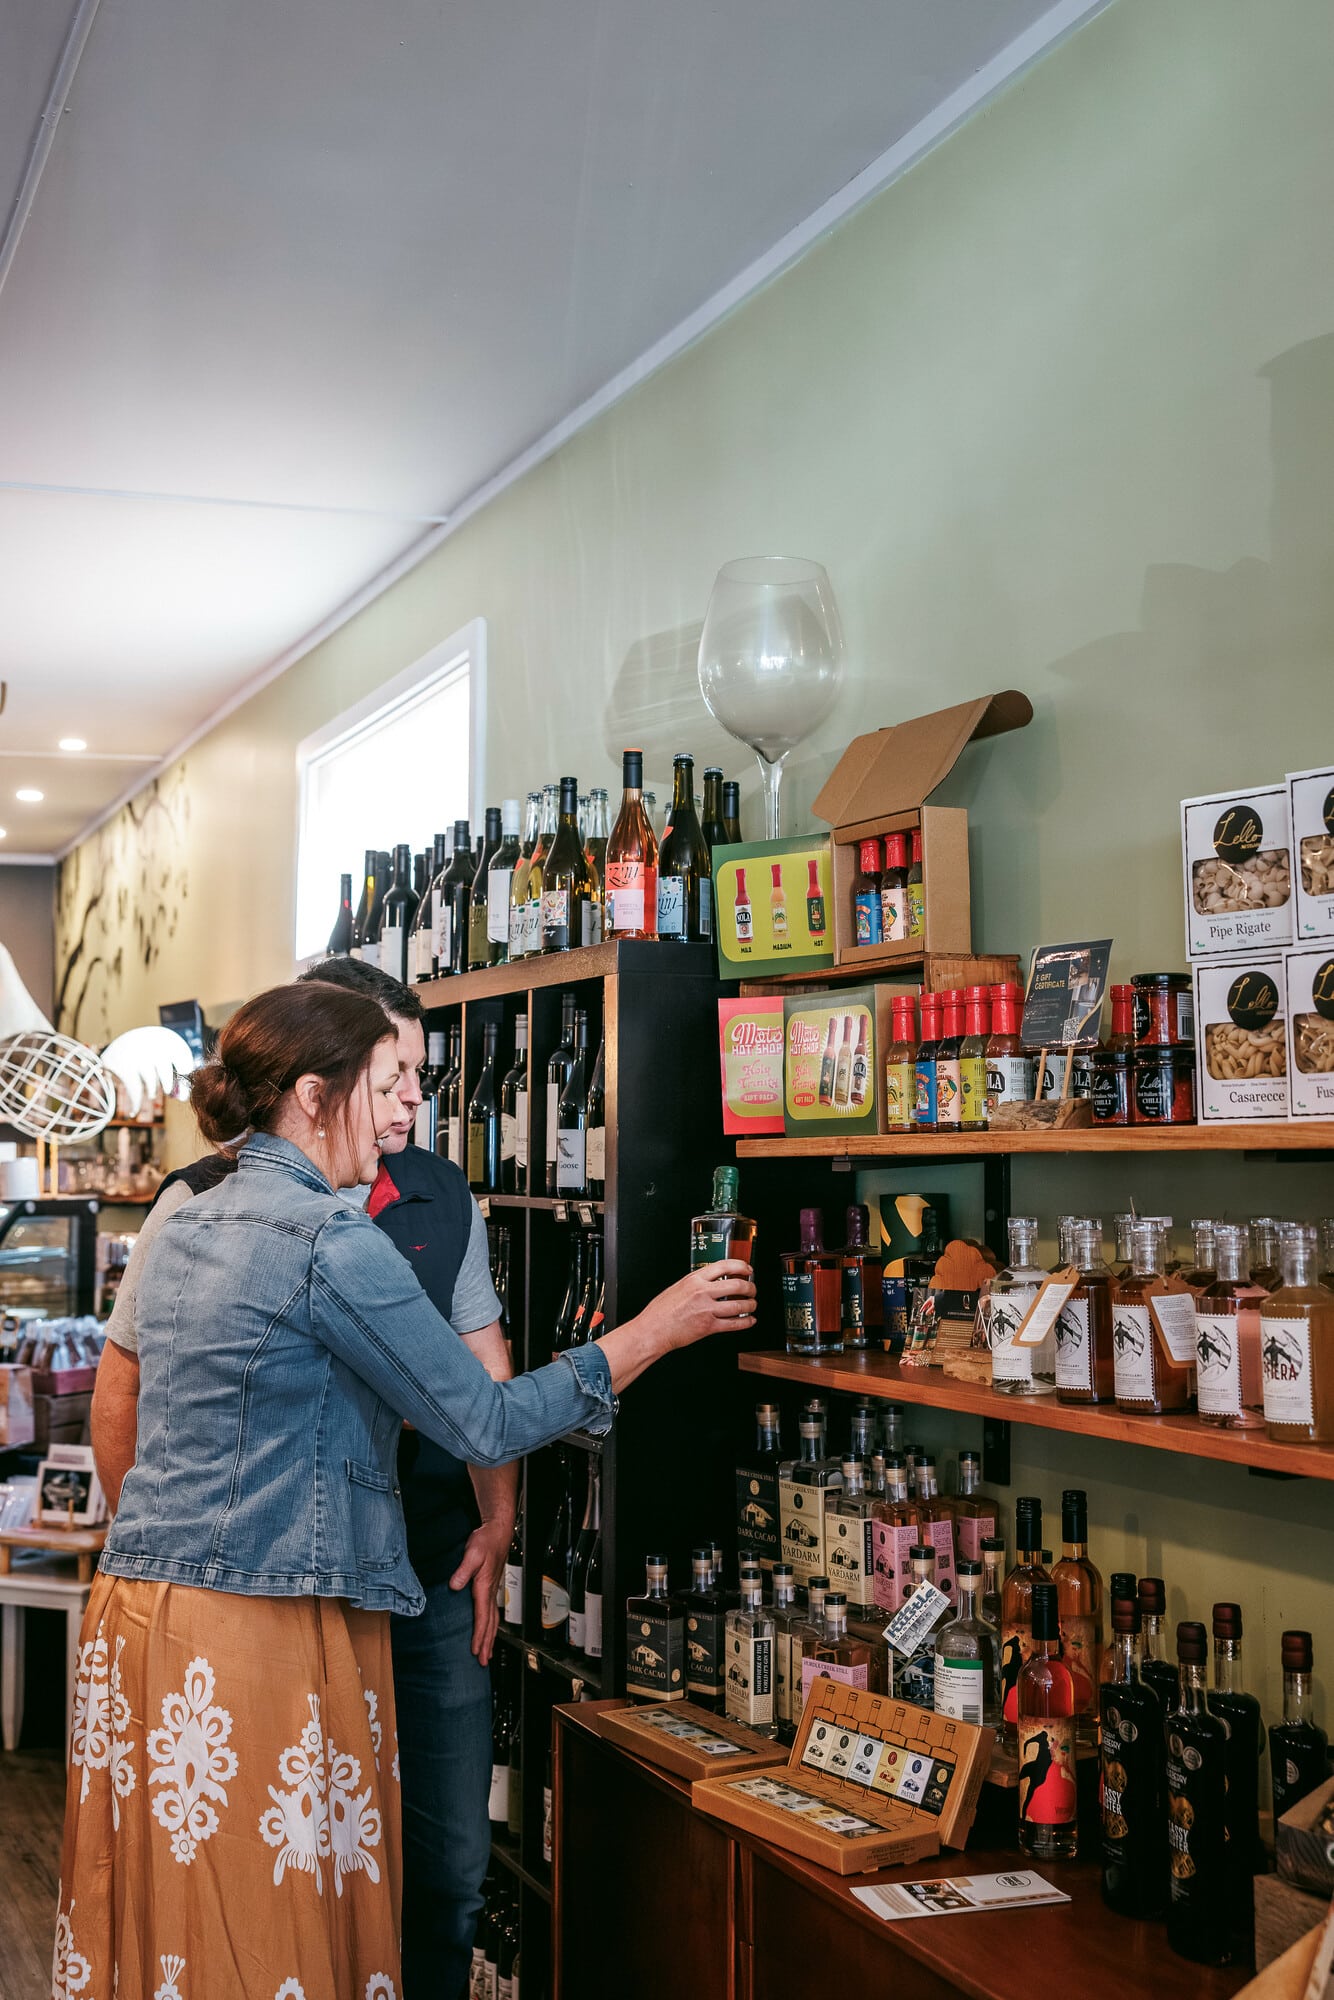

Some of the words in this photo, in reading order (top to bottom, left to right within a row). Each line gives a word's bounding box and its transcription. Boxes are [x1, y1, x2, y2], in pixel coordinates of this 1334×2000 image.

[1213, 812, 1263, 848] Lello
[1210, 926, 1233, 939] Pipe
[1235, 921, 1271, 937] Rigate
[772, 943, 792, 951] MEDIUM
[1040, 973, 1052, 981] GIFT
[1034, 980, 1065, 990] CERTIFICATE
[1228, 977, 1279, 1011] Lello
[731, 1044, 752, 1056] HOT
[755, 1043, 783, 1056] SHOP
[789, 1045, 802, 1056] HOT
[803, 1043, 820, 1055] SHOP
[1229, 1091, 1285, 1104] Casarecce
[737, 1526, 753, 1538] DARK
[754, 1531, 777, 1543] CACAO
[782, 1544, 820, 1563] YARDARM
[828, 1567, 860, 1582] YARDARM
[886, 1588, 936, 1638] hustle
[626, 1664, 643, 1674] DARK
[643, 1667, 666, 1679] CACAO
[690, 1663, 713, 1674] CACAO
